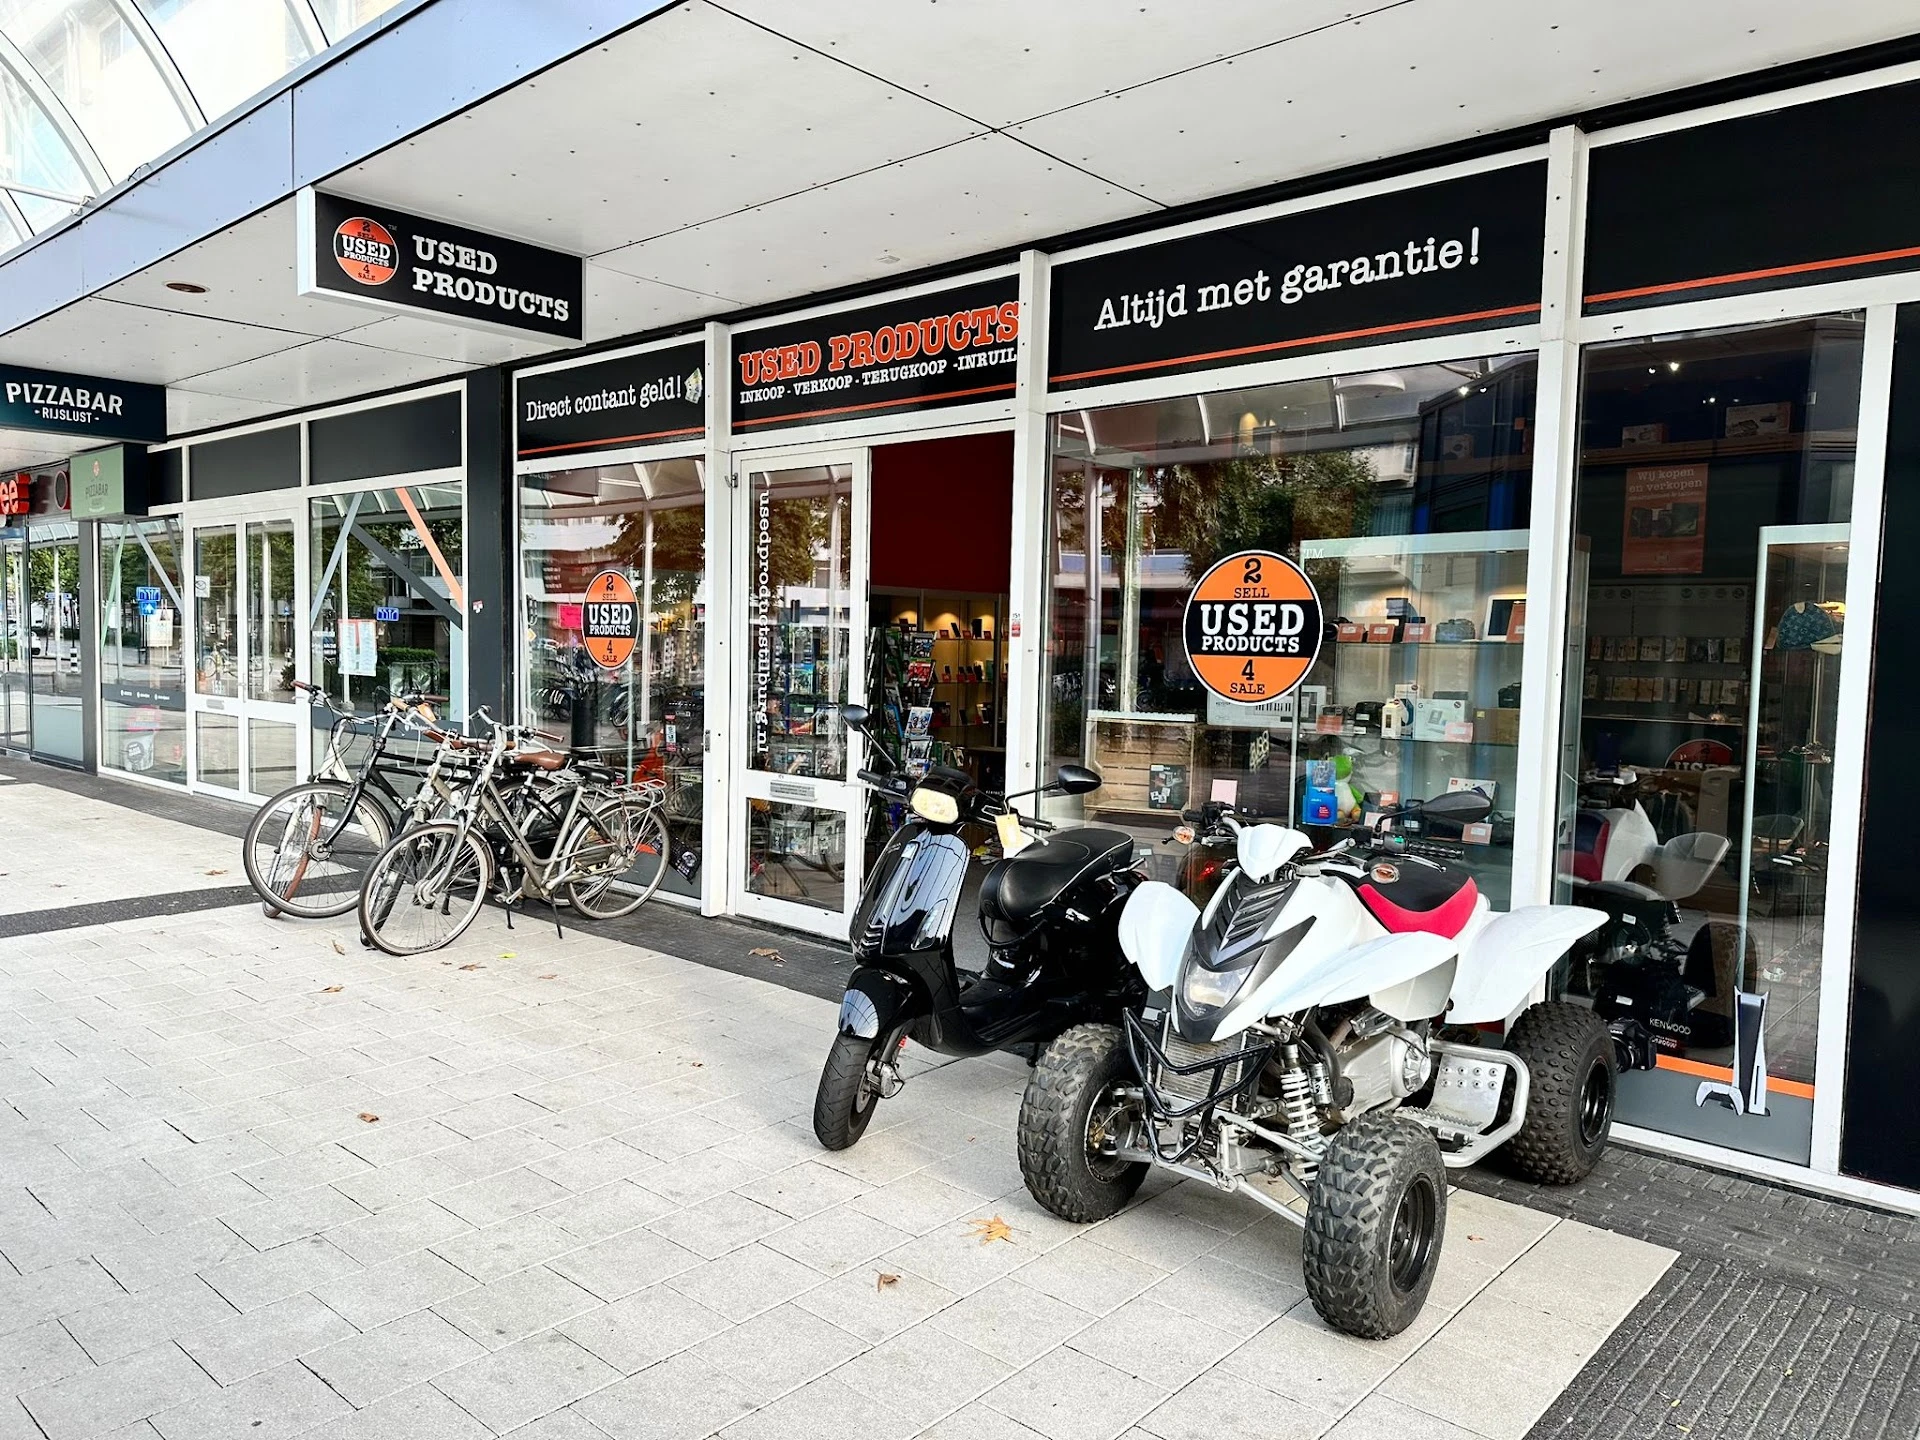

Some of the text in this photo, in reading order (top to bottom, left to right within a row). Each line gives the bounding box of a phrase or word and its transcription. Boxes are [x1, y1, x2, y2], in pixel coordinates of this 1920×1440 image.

[362, 221, 371, 232] 2
[341, 234, 391, 260] USED
[411, 234, 498, 276] USED
[343, 250, 390, 267] PRODUCTS
[357, 272, 376, 281] SALE
[362, 264, 370, 274] 4
[1093, 226, 1480, 330] Altijd met garantie!
[411, 267, 569, 322] PRODUCTS
[738, 300, 1019, 387] USED PRODUCTS
[739, 386, 785, 404] INKOOP
[793, 374, 853, 396] VERKOOP
[862, 359, 947, 386] TERUGKOOP
[5, 382, 123, 416] PIZZABAR
[525, 374, 682, 422] Direct contant geld!
[42, 407, 92, 423] RIJSLUST
[1637, 468, 1694, 480] Wij kopen
[85, 483, 109, 498] PIZZABAR
[1629, 479, 1703, 493] en verkopen
[1304, 548, 1325, 558] TM
[1243, 557, 1262, 584] 2
[605, 574, 614, 592] 2
[1233, 587, 1270, 599] SELL
[588, 603, 633, 625] USED
[1200, 603, 1305, 636] USED
[589, 624, 631, 636] PRODUCTS
[606, 639, 613, 654] 4
[1201, 635, 1300, 653] PRODUCTS
[602, 654, 618, 663] SALE
[1241, 659, 1255, 681] 4
[1229, 682, 1266, 695] SALE
[1649, 1018, 1691, 1034] KENWOOD
